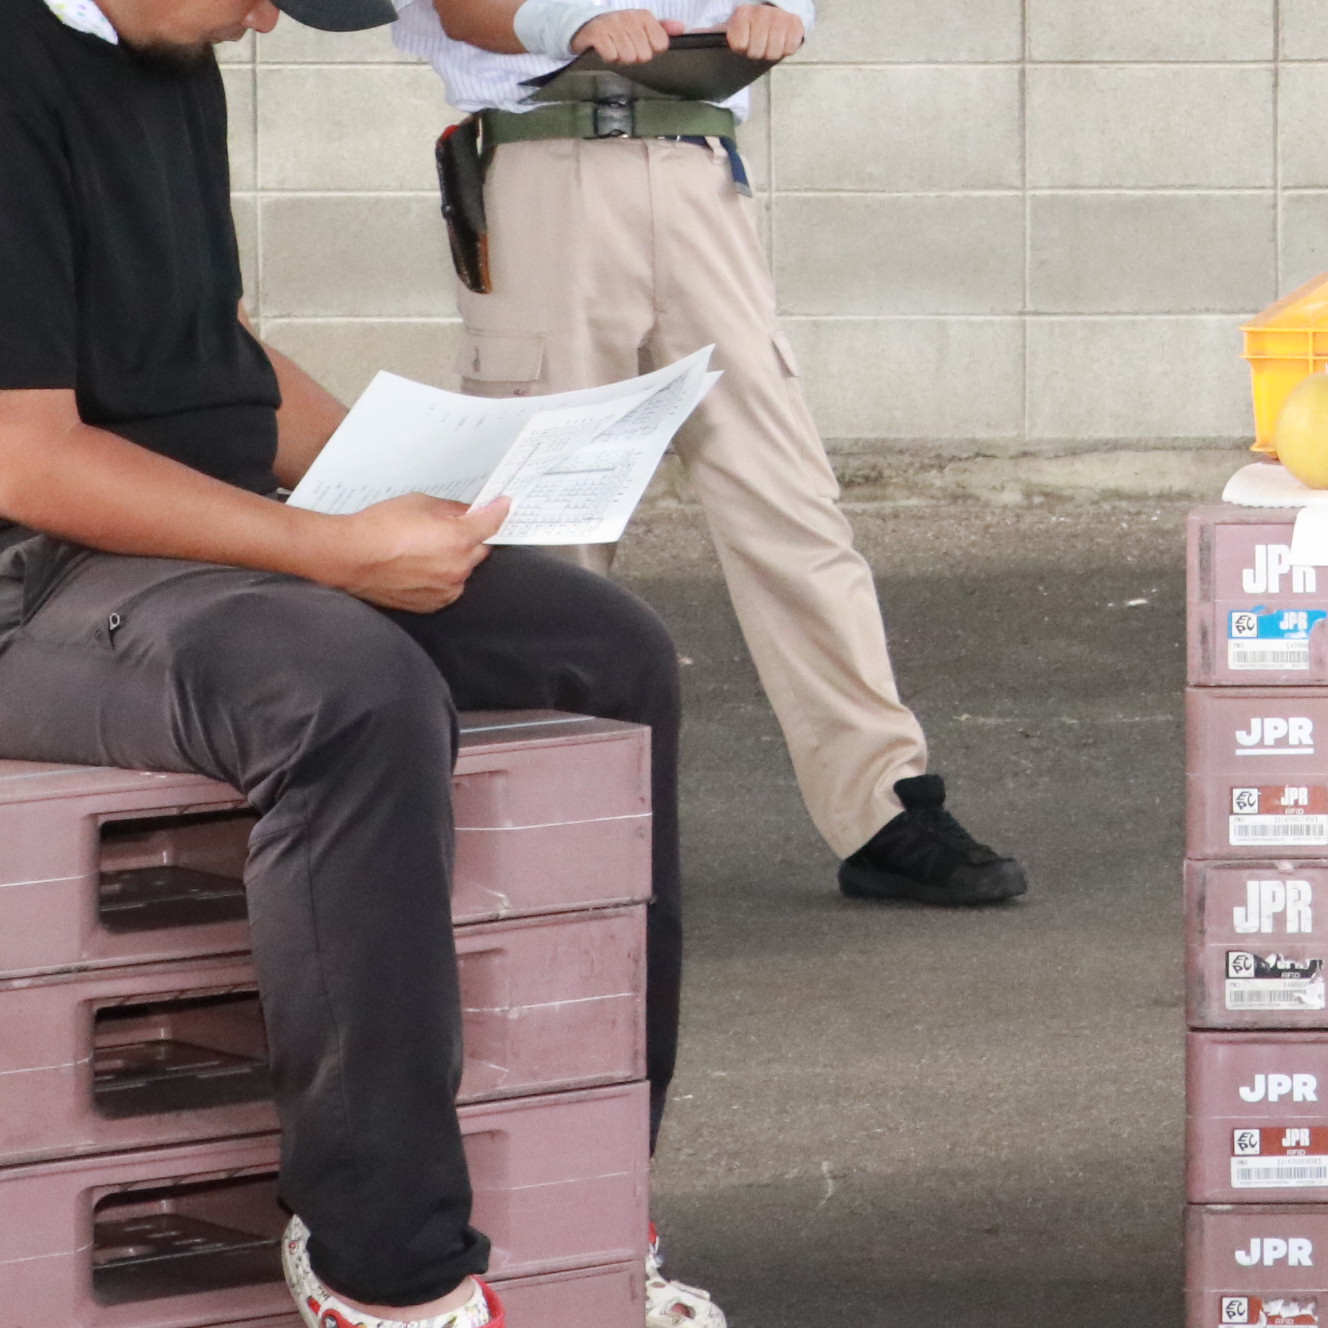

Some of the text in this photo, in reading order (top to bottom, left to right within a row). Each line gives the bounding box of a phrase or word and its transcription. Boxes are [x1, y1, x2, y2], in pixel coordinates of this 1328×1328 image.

[1235, 717, 1313, 746] JPR
[1281, 787, 1308, 806] JPR
[1233, 880, 1312, 933] JPR
[1239, 1073, 1318, 1102] JPR
[1282, 1128, 1310, 1147] JPR
[1235, 1238, 1313, 1266] JPR
